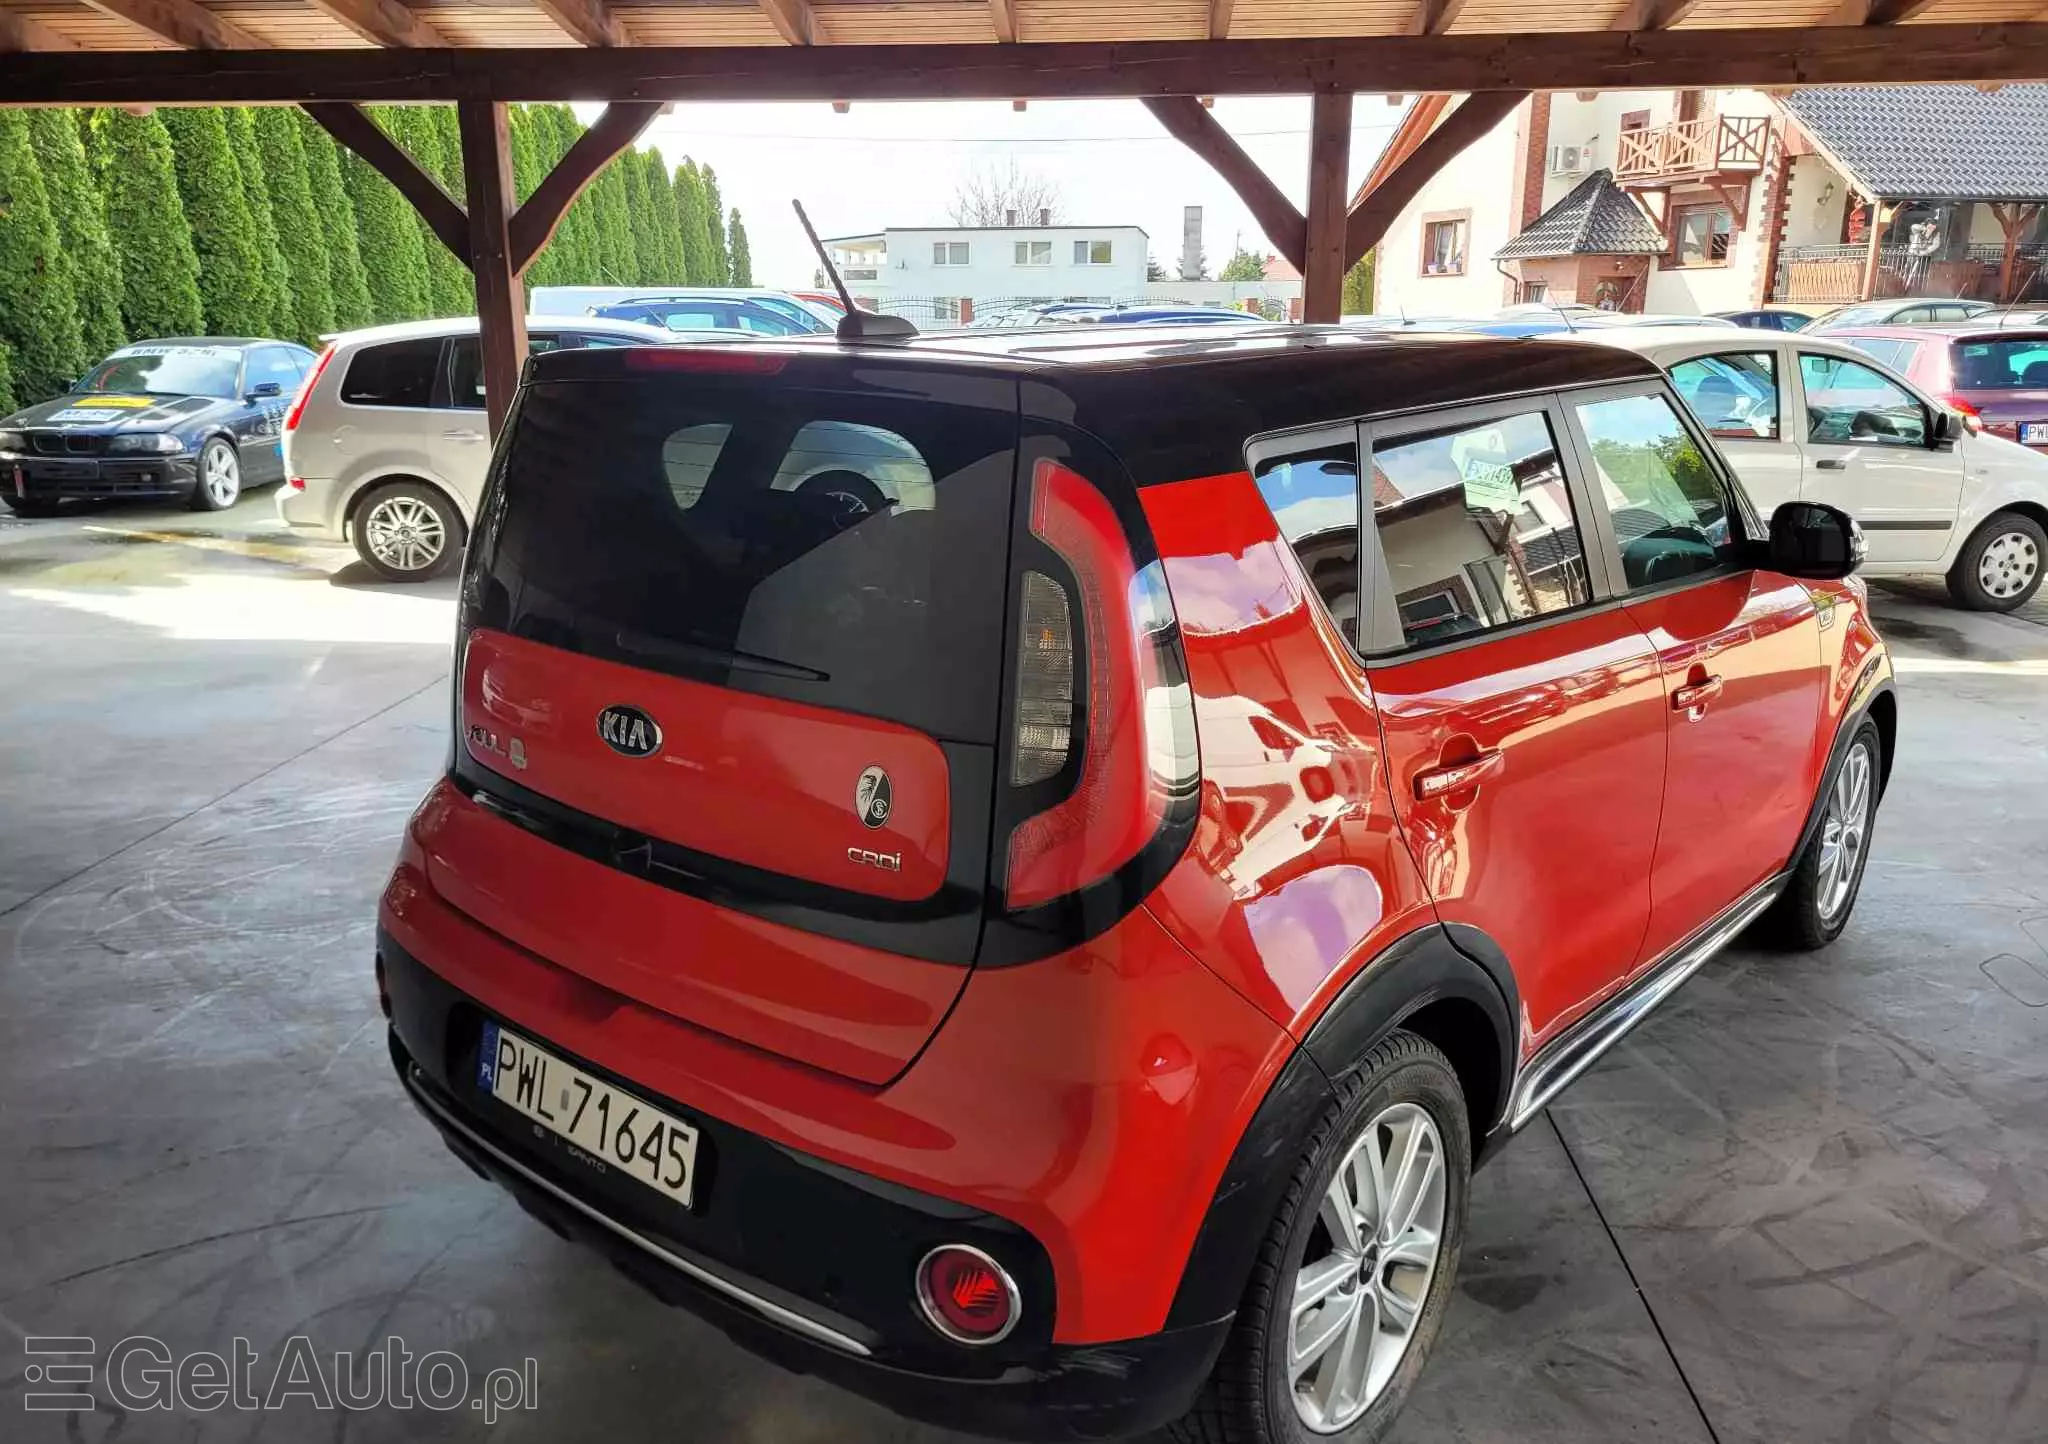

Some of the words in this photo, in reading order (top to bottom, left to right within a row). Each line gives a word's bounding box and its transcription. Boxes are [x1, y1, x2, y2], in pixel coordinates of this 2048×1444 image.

[603, 710, 648, 751] KIA
[481, 1061, 493, 1082] PL
[495, 1037, 555, 1122] PWL
[568, 1076, 690, 1189] 71645
